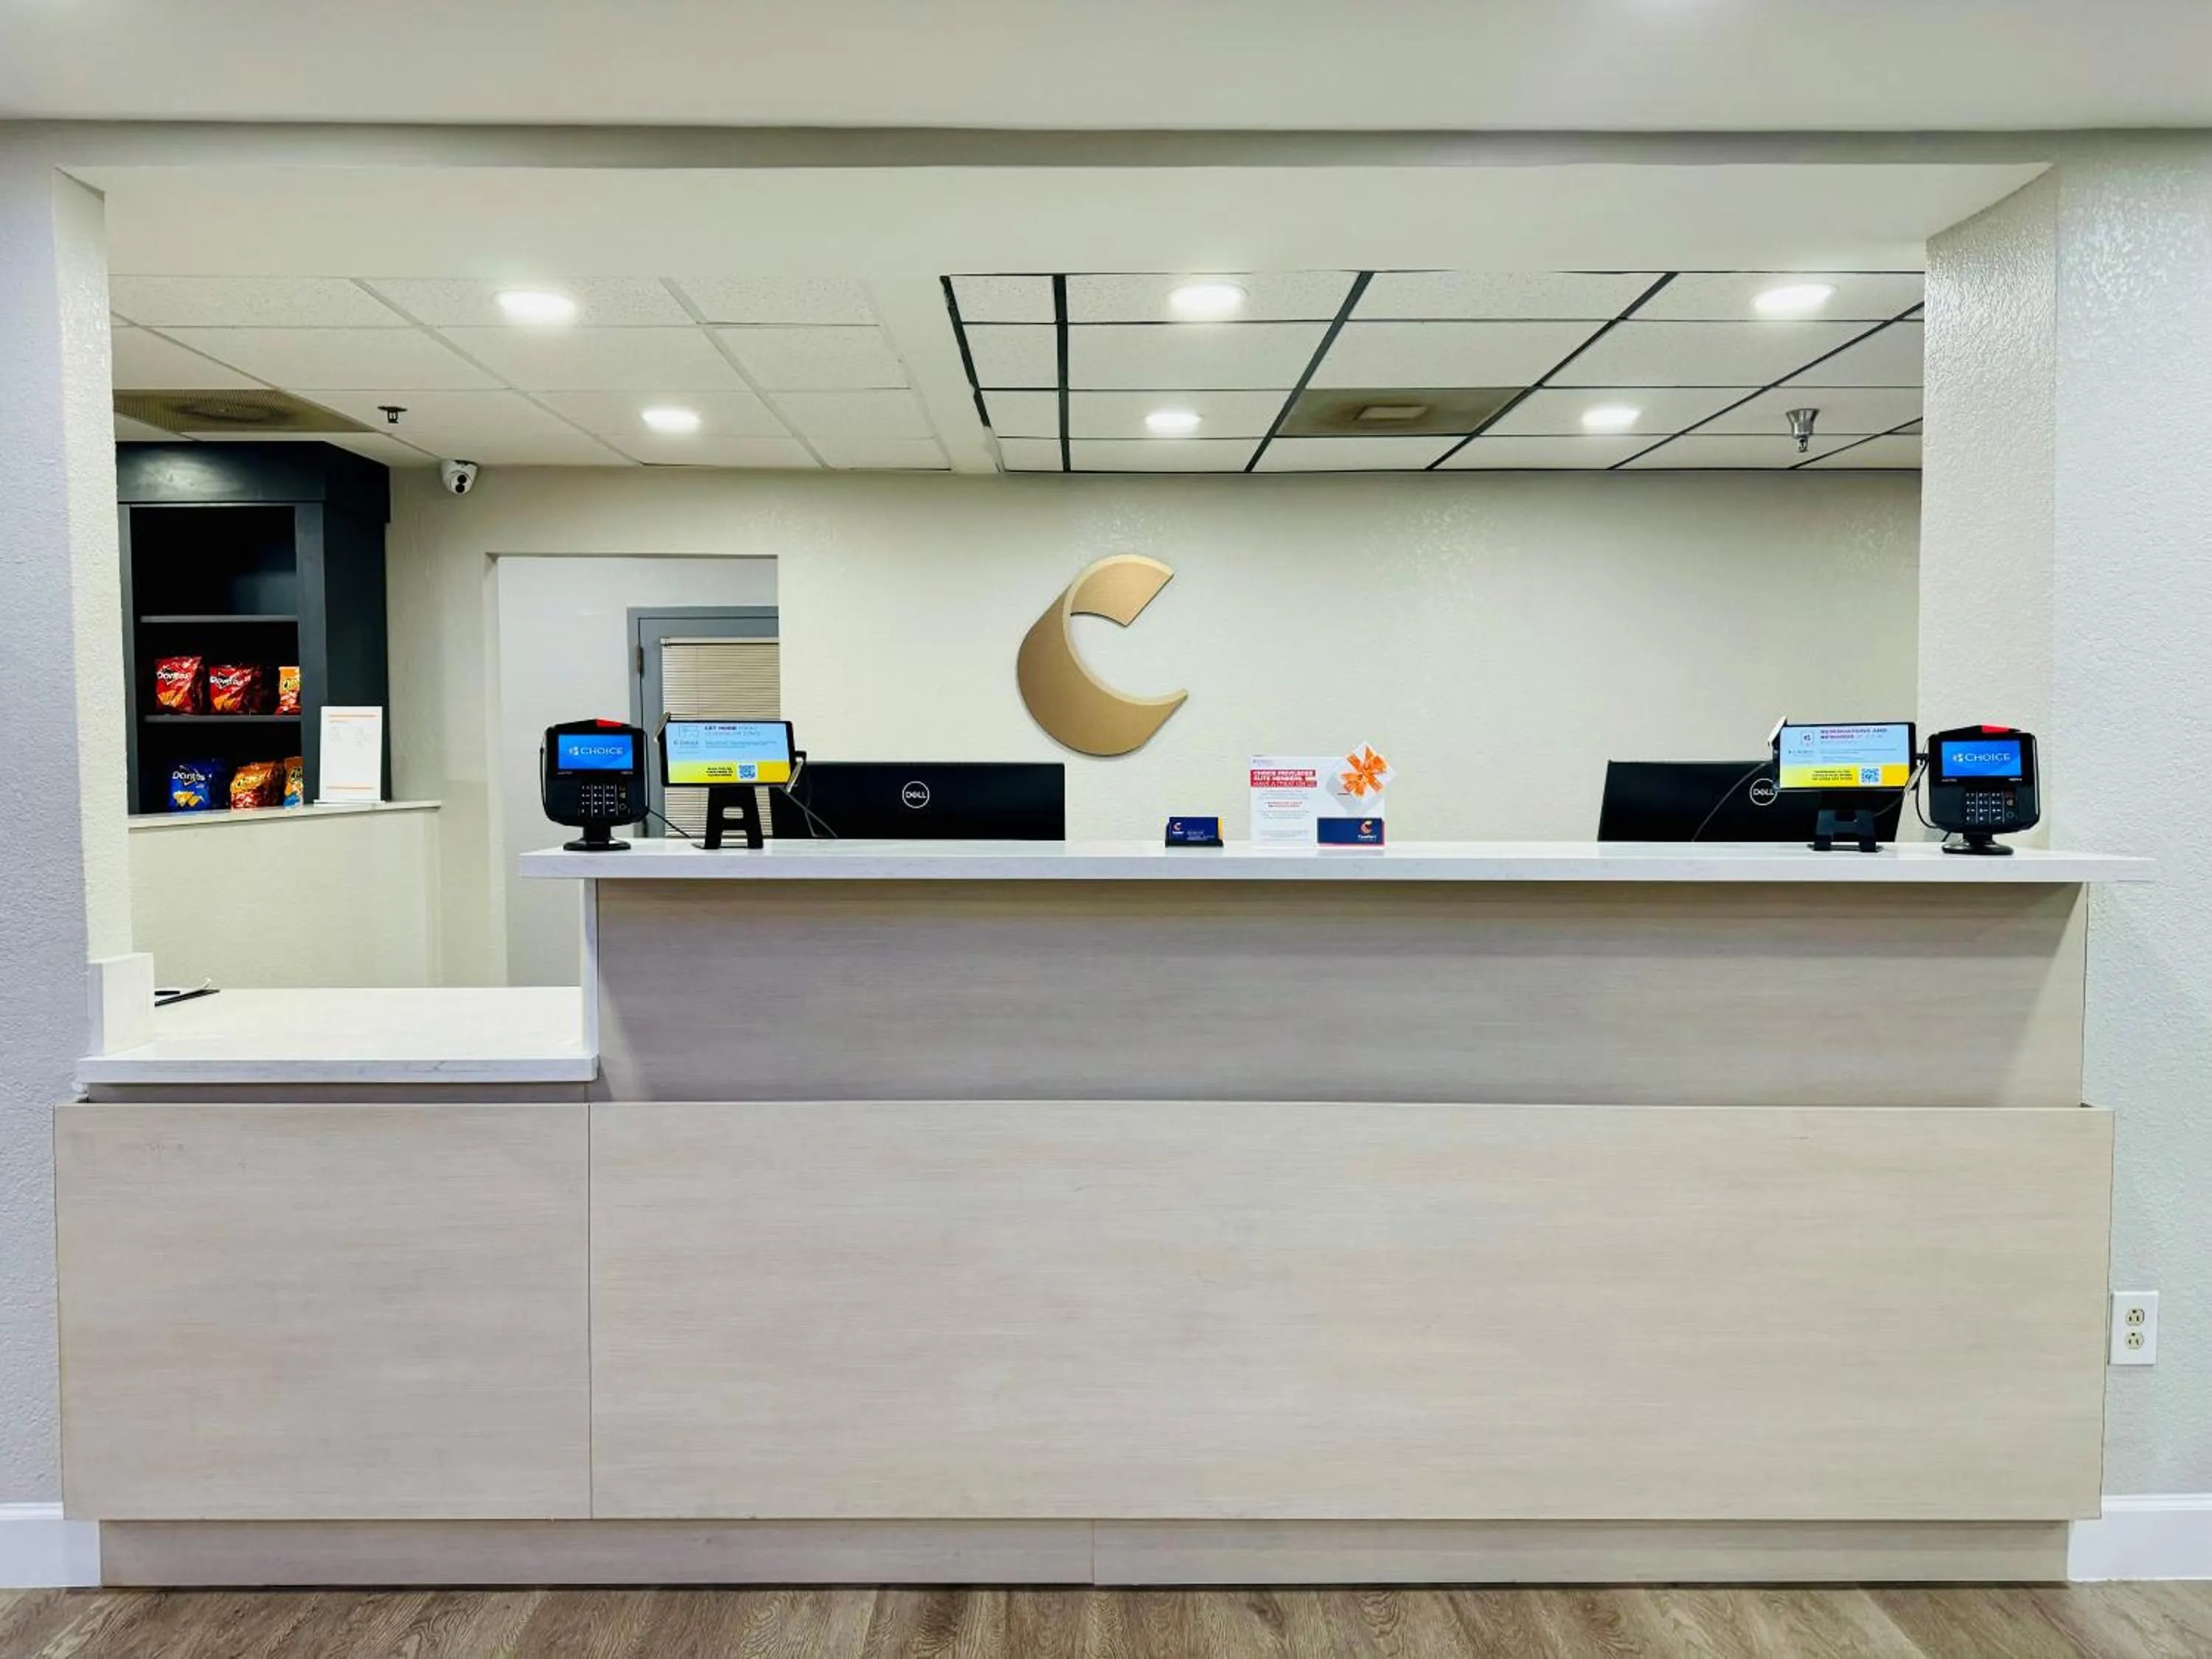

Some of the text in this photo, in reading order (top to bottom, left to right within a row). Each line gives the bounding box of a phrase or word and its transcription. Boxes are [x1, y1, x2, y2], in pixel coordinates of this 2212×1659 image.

[580, 746, 623, 755] CHOICE
[1965, 753, 2011, 762] CHOICE
[173, 771, 205, 781] Doritos
